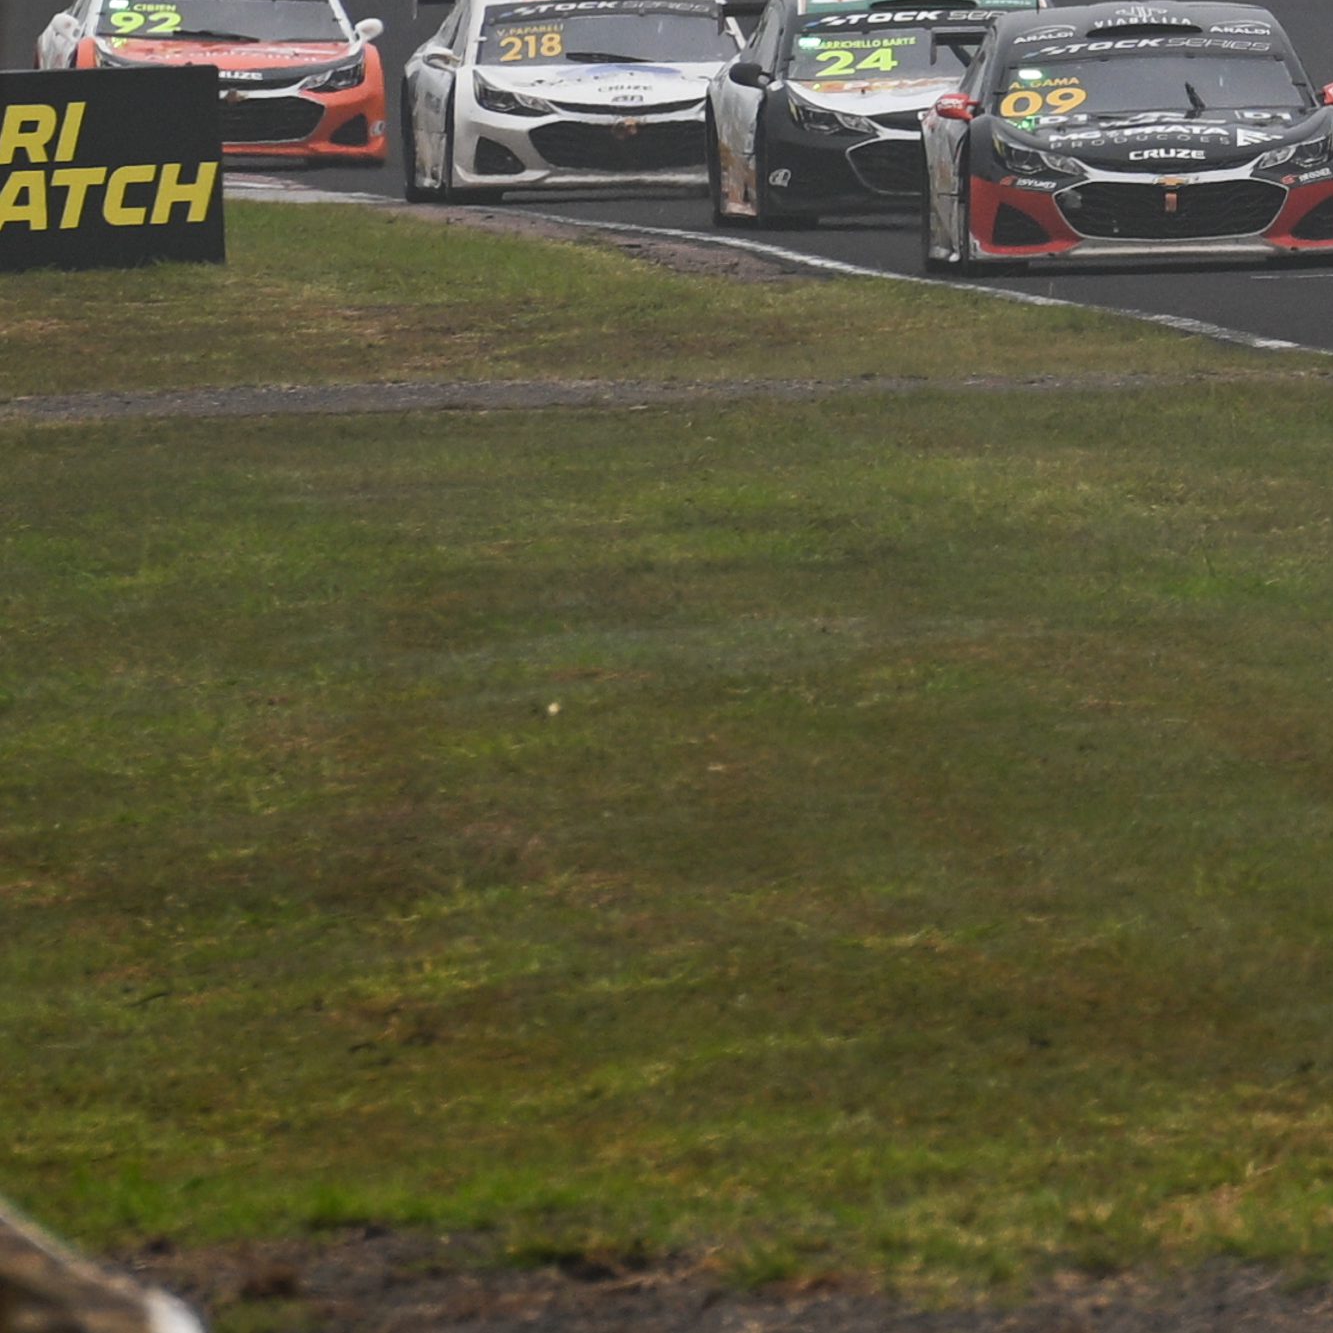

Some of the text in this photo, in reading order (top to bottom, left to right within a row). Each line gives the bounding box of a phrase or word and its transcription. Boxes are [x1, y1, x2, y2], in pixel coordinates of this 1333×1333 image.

[110, 11, 181, 34] 92
[817, 10, 945, 26] STOCK
[499, 33, 562, 61] 218
[1040, 37, 1165, 55] STOCK
[815, 48, 898, 77] 24
[1001, 87, 1087, 117] 09
[1129, 148, 1206, 161] CRUZE
